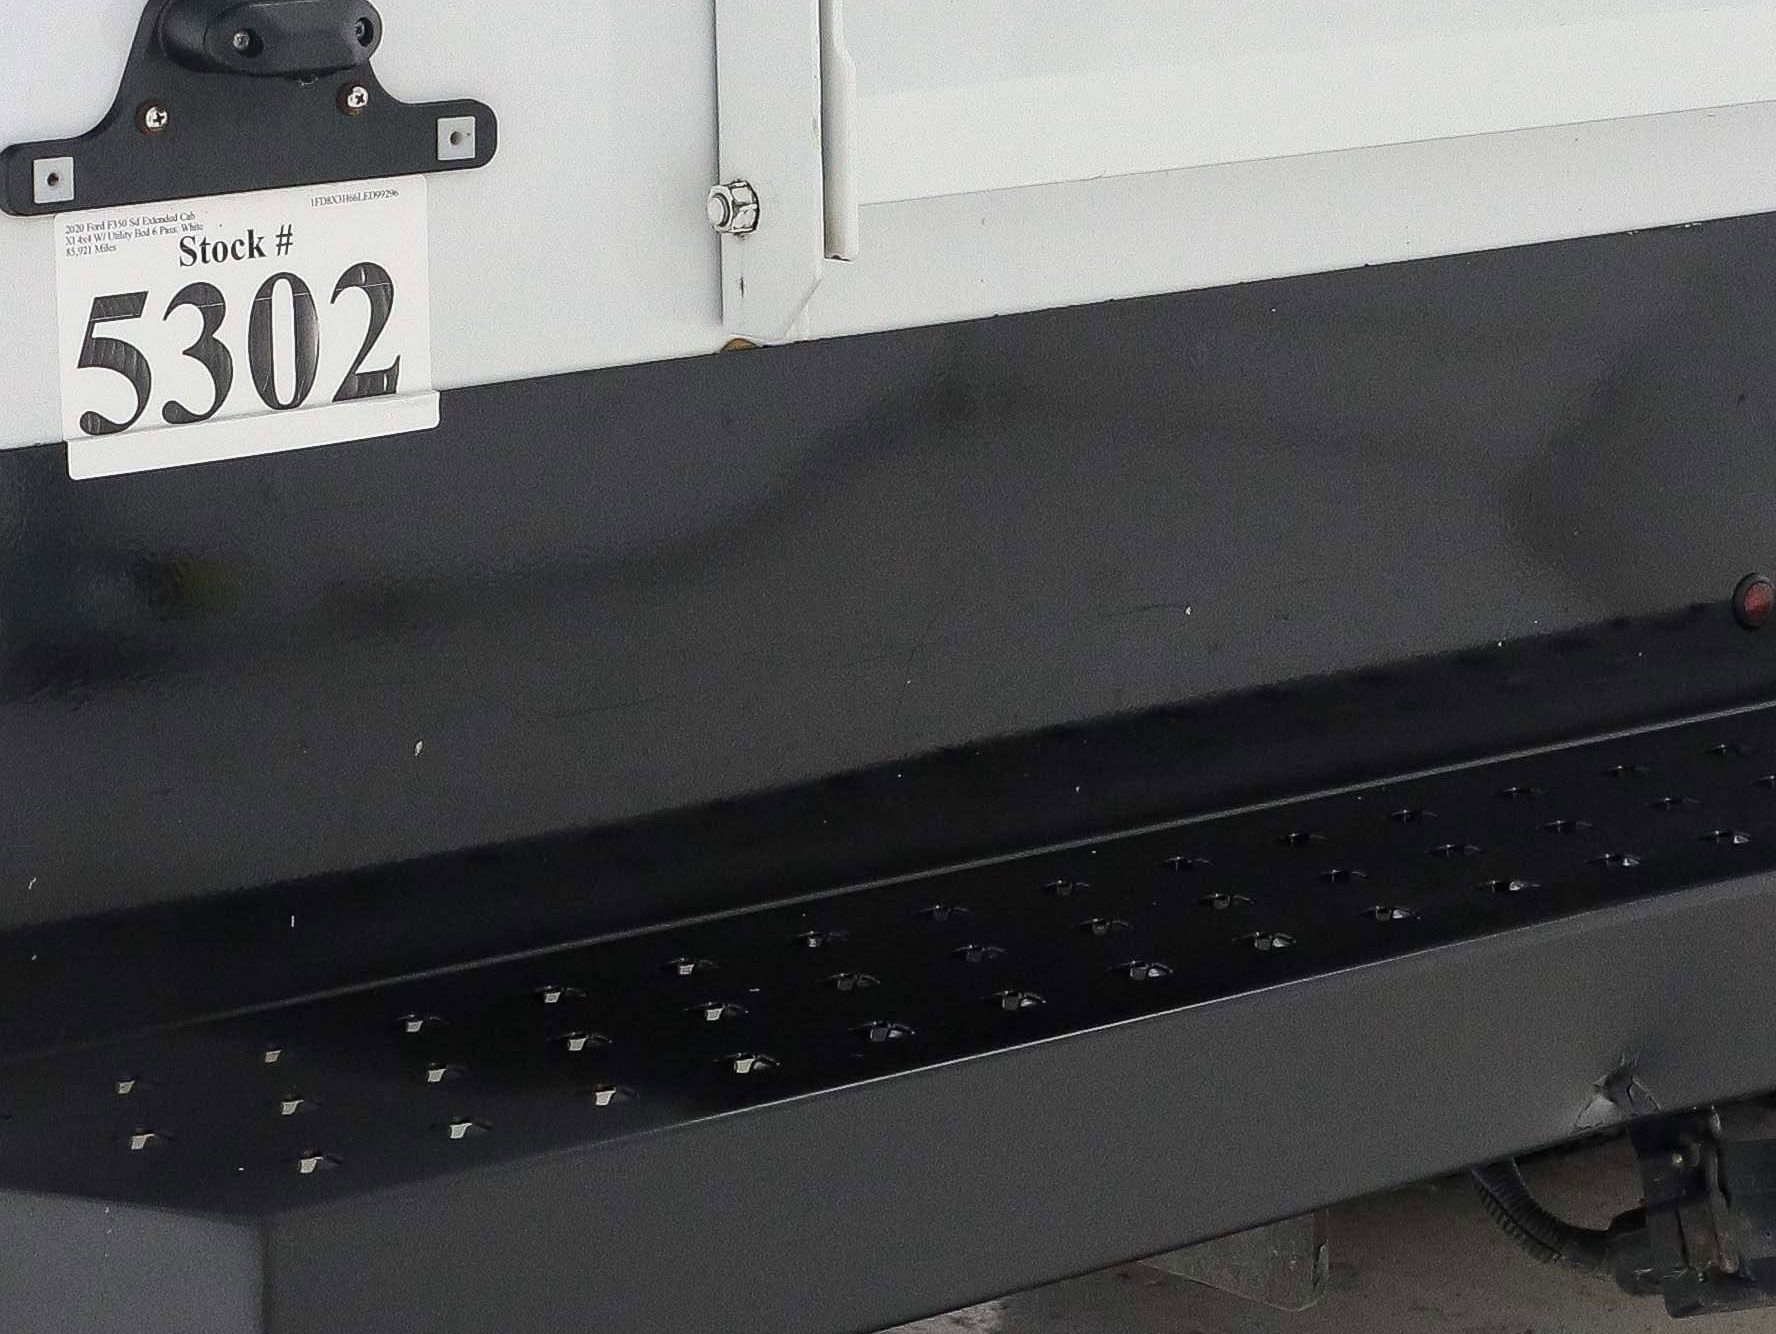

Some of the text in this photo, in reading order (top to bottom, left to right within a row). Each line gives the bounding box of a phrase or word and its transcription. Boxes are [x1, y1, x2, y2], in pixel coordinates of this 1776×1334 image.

[65, 225, 84, 234] 2020
[86, 221, 105, 232] Ford
[107, 219, 128, 230] F350
[142, 213, 178, 225] Extended
[180, 211, 196, 221] Cab
[108, 229, 133, 241] Utility
[181, 222, 204, 232] White
[94, 242, 117, 252] Miles
[178, 223, 294, 268] Stock #
[76, 261, 401, 437] 5302
